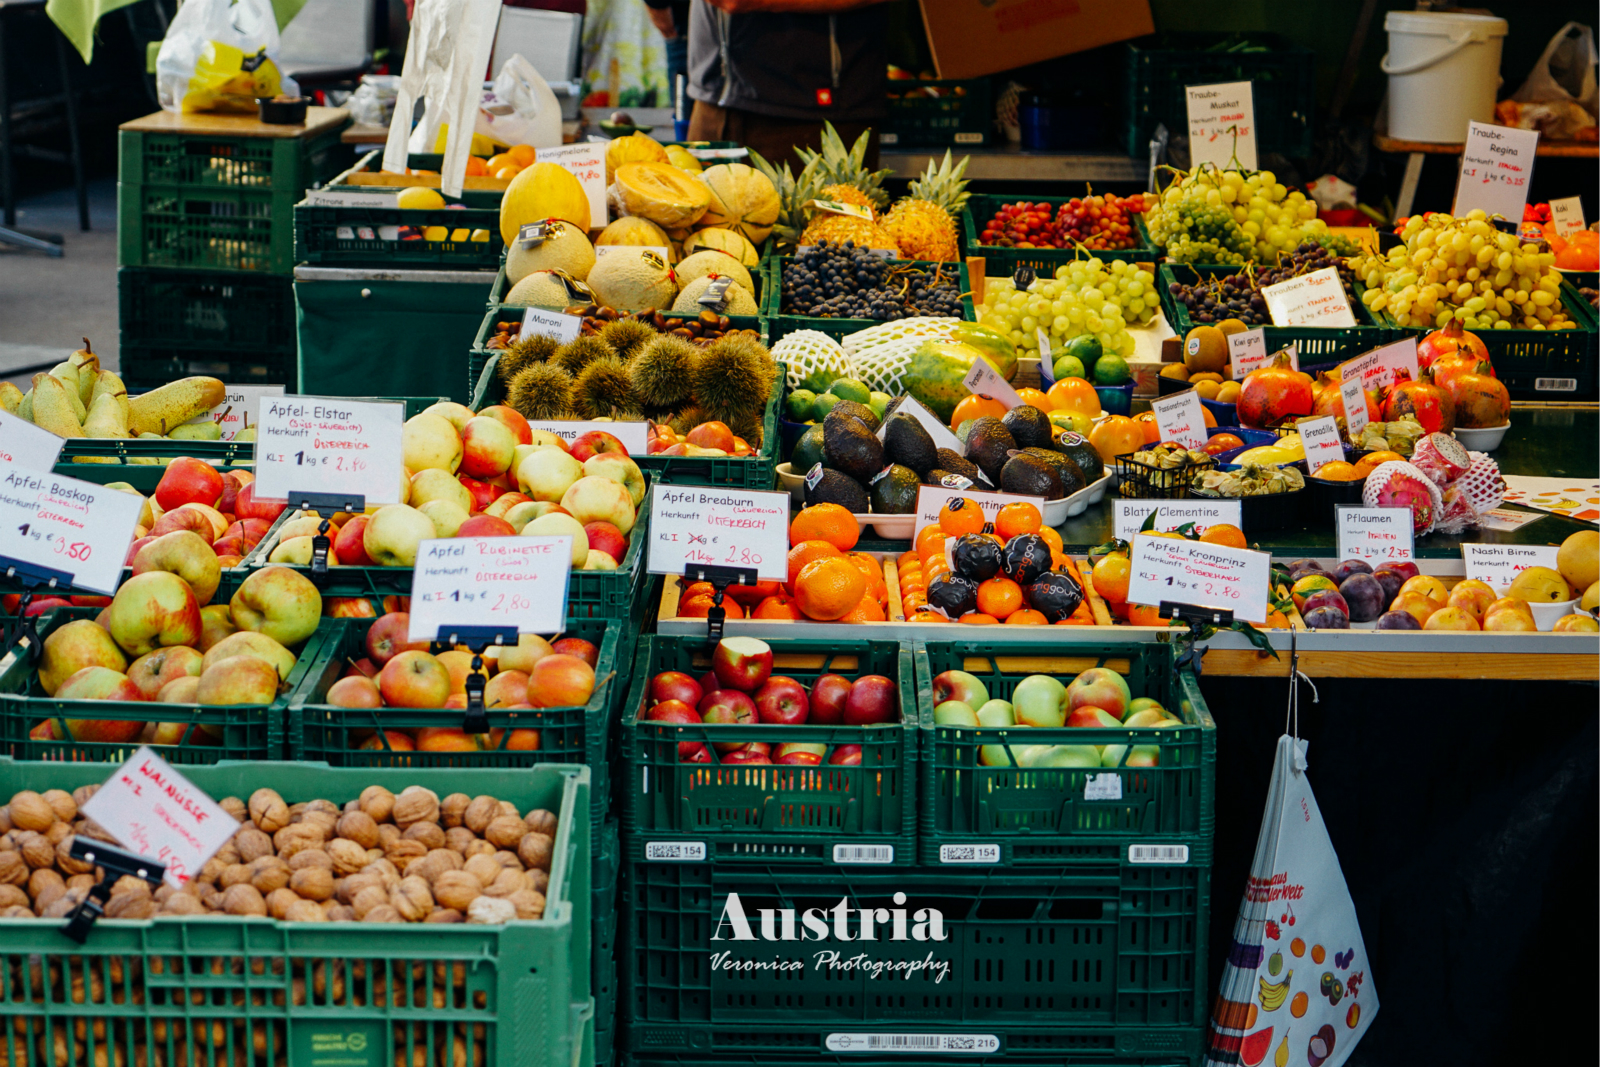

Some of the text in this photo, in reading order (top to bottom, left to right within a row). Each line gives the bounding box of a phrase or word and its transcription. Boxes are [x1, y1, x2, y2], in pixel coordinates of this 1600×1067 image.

[1189, 90, 1221, 99] Traube-
[1210, 100, 1239, 110] Muskat
[1471, 127, 1505, 139] Traube-
[538, 146, 591, 160] Honigmelone
[1490, 143, 1518, 156] Regina
[314, 197, 343, 207] Zitrone
[1268, 282, 1304, 297] Trauben
[531, 314, 562, 328] Maroni
[1342, 354, 1379, 380] Granatäpfel
[1364, 365, 1386, 380] ISRAEL
[269, 401, 353, 420] Äpfel- Elstar
[267, 426, 309, 437] Herkunft
[294, 450, 304, 466] 1
[306, 455, 317, 467] kg
[321, 456, 329, 465] €
[5, 470, 95, 504] Äpfel- Boskop
[662, 490, 754, 507] Äpfel Breaburn
[660, 511, 700, 520] Herkunft
[1123, 506, 1220, 517] Blatt Clementine
[1346, 513, 1392, 523] Pflaumen
[18, 523, 30, 536] 1
[30, 529, 42, 541] kg
[46, 533, 54, 541] €
[1368, 530, 1397, 540] ITALIEN
[712, 536, 718, 544] €
[428, 544, 465, 559] Äpfel
[1146, 540, 1247, 568] Äpfel- Kronprinz
[1371, 547, 1379, 555] kg
[1472, 547, 1537, 557] Nashi Birne
[1143, 554, 1182, 567] Herkunft
[425, 567, 469, 576] Herkunft
[1165, 576, 1174, 586] 1
[1176, 579, 1187, 589] kg
[450, 589, 460, 602] 1
[464, 592, 475, 602] kg
[480, 590, 488, 599] €
[683, 846, 702, 855] 154
[978, 847, 996, 857] 154
[1281, 884, 1304, 900] Welt
[977, 1039, 996, 1048] 216
